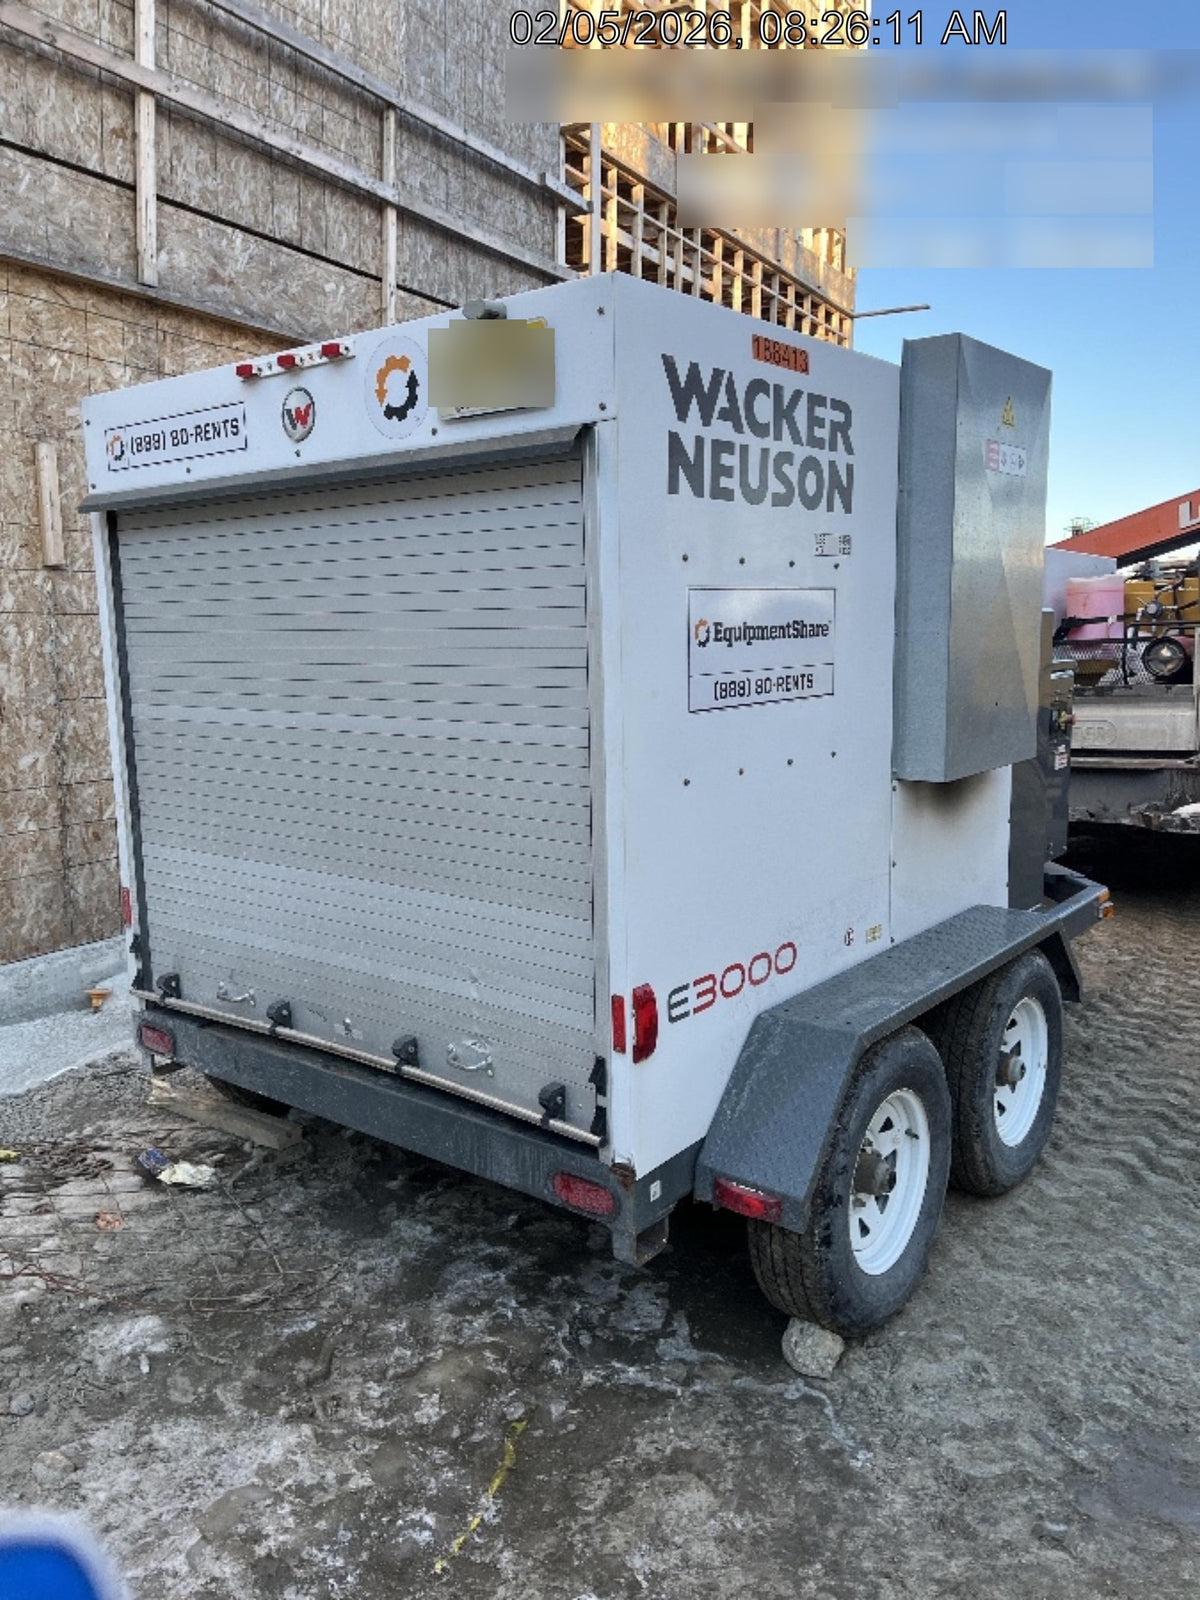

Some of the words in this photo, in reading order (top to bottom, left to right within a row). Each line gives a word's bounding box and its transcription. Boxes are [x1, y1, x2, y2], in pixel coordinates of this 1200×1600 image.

[661, 353, 855, 456] WACKER
[667, 430, 854, 514] NEUSON
[713, 620, 829, 647] EquipmentShare
[668, 941, 797, 1023] E3000
